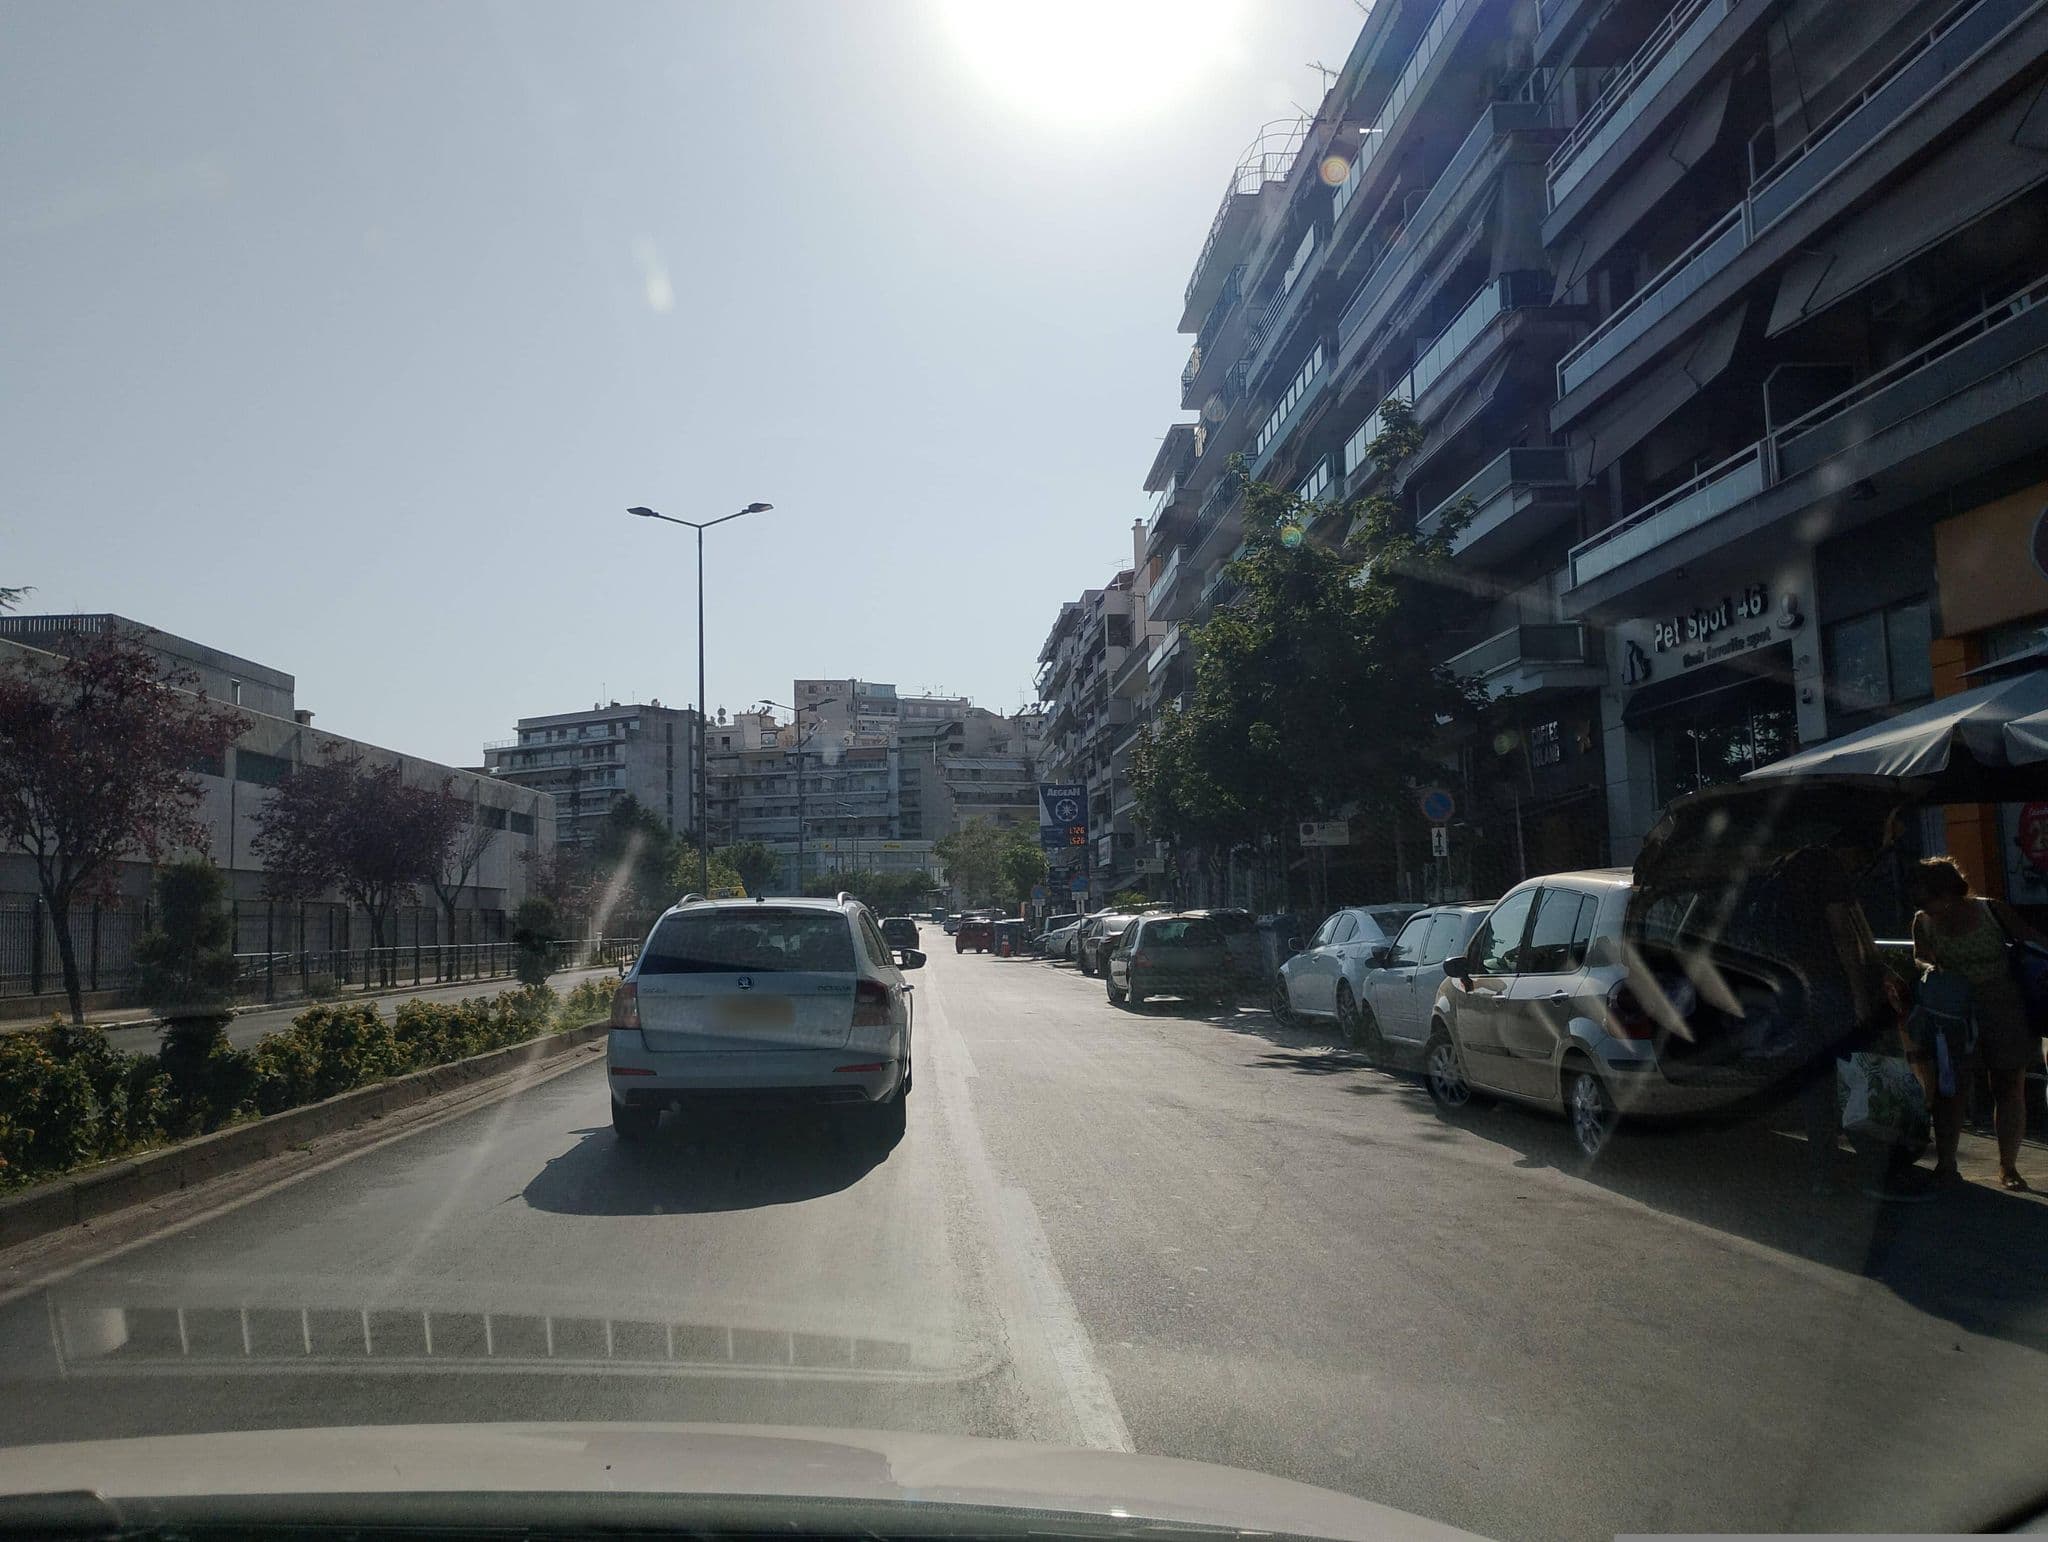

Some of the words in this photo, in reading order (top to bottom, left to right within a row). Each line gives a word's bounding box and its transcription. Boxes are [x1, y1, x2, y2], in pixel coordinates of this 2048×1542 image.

[1655, 617, 1681, 652] Pet
[1687, 601, 1728, 642] Spot
[1737, 585, 1763, 618] 46
[1046, 787, 1081, 797] AEGEAN
